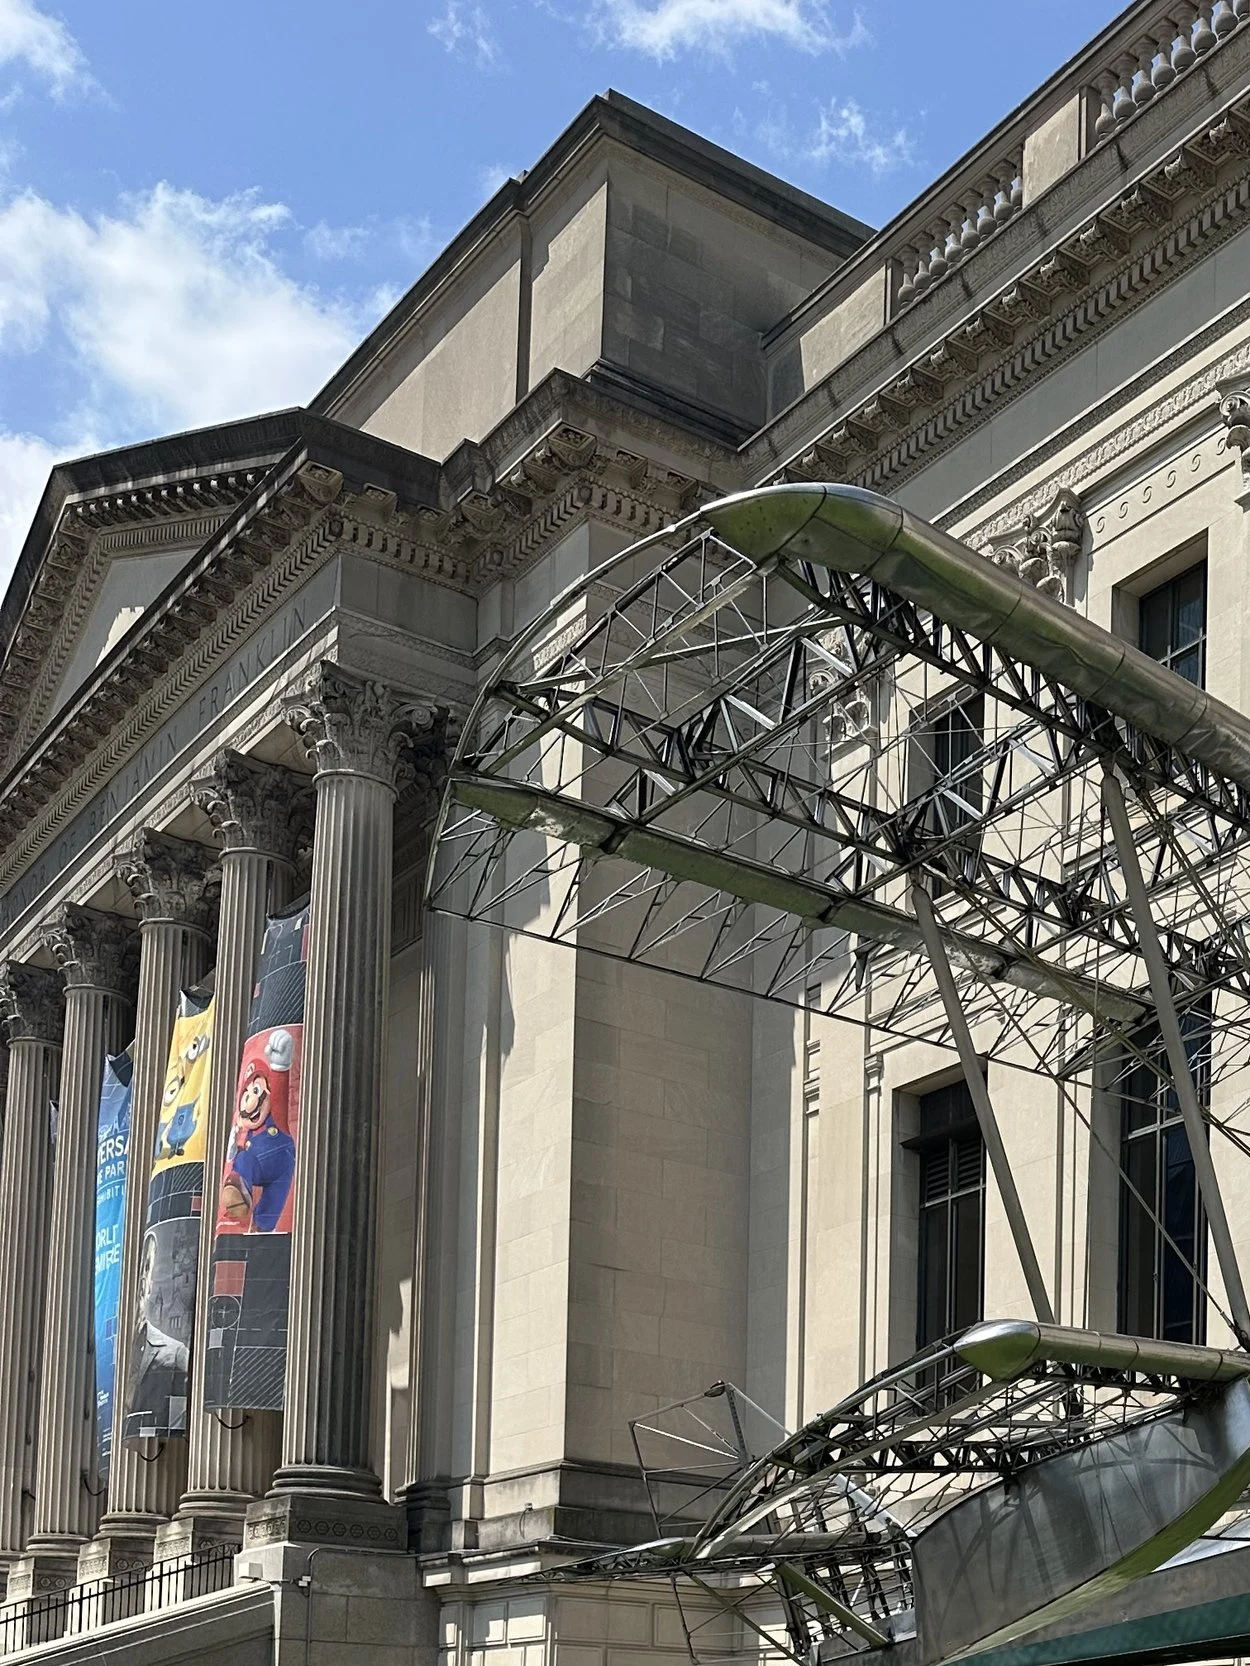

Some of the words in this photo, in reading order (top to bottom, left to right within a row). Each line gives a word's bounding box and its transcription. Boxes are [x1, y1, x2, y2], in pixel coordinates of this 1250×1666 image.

[90, 725, 178, 838] BENJAMIN
[198, 598, 306, 731] FRANKLIN
[105, 1160, 127, 1180] PAR
